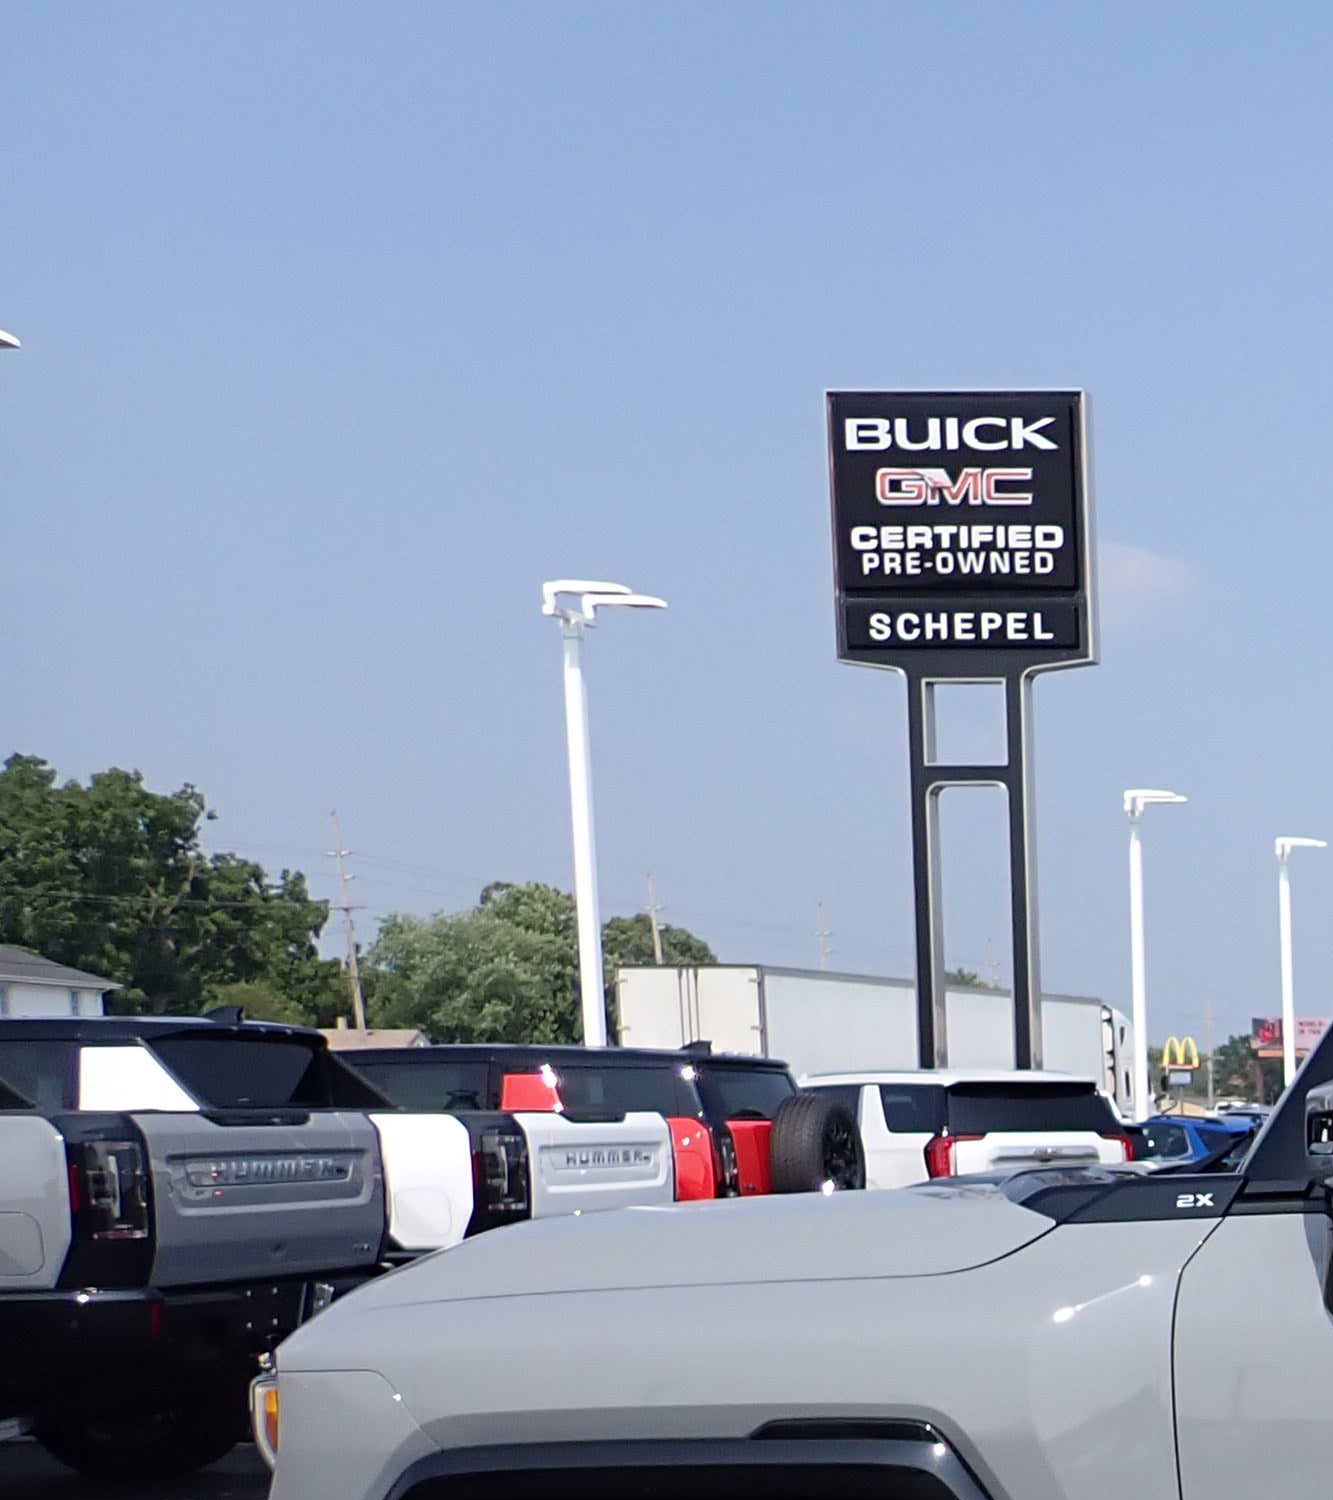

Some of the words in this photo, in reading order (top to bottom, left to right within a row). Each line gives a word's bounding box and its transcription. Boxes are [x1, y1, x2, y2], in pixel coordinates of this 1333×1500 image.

[845, 416, 1059, 451] BUICK
[875, 467, 1033, 506] GMC
[850, 525, 1064, 550] CERTIFIED
[862, 552, 1054, 575] PRE-OWNED
[868, 612, 1054, 641] SCHEPEL
[210, 1157, 334, 1182] HUMMER
[566, 1150, 643, 1167] HUMMER
[1176, 1193, 1215, 1208] 2X
